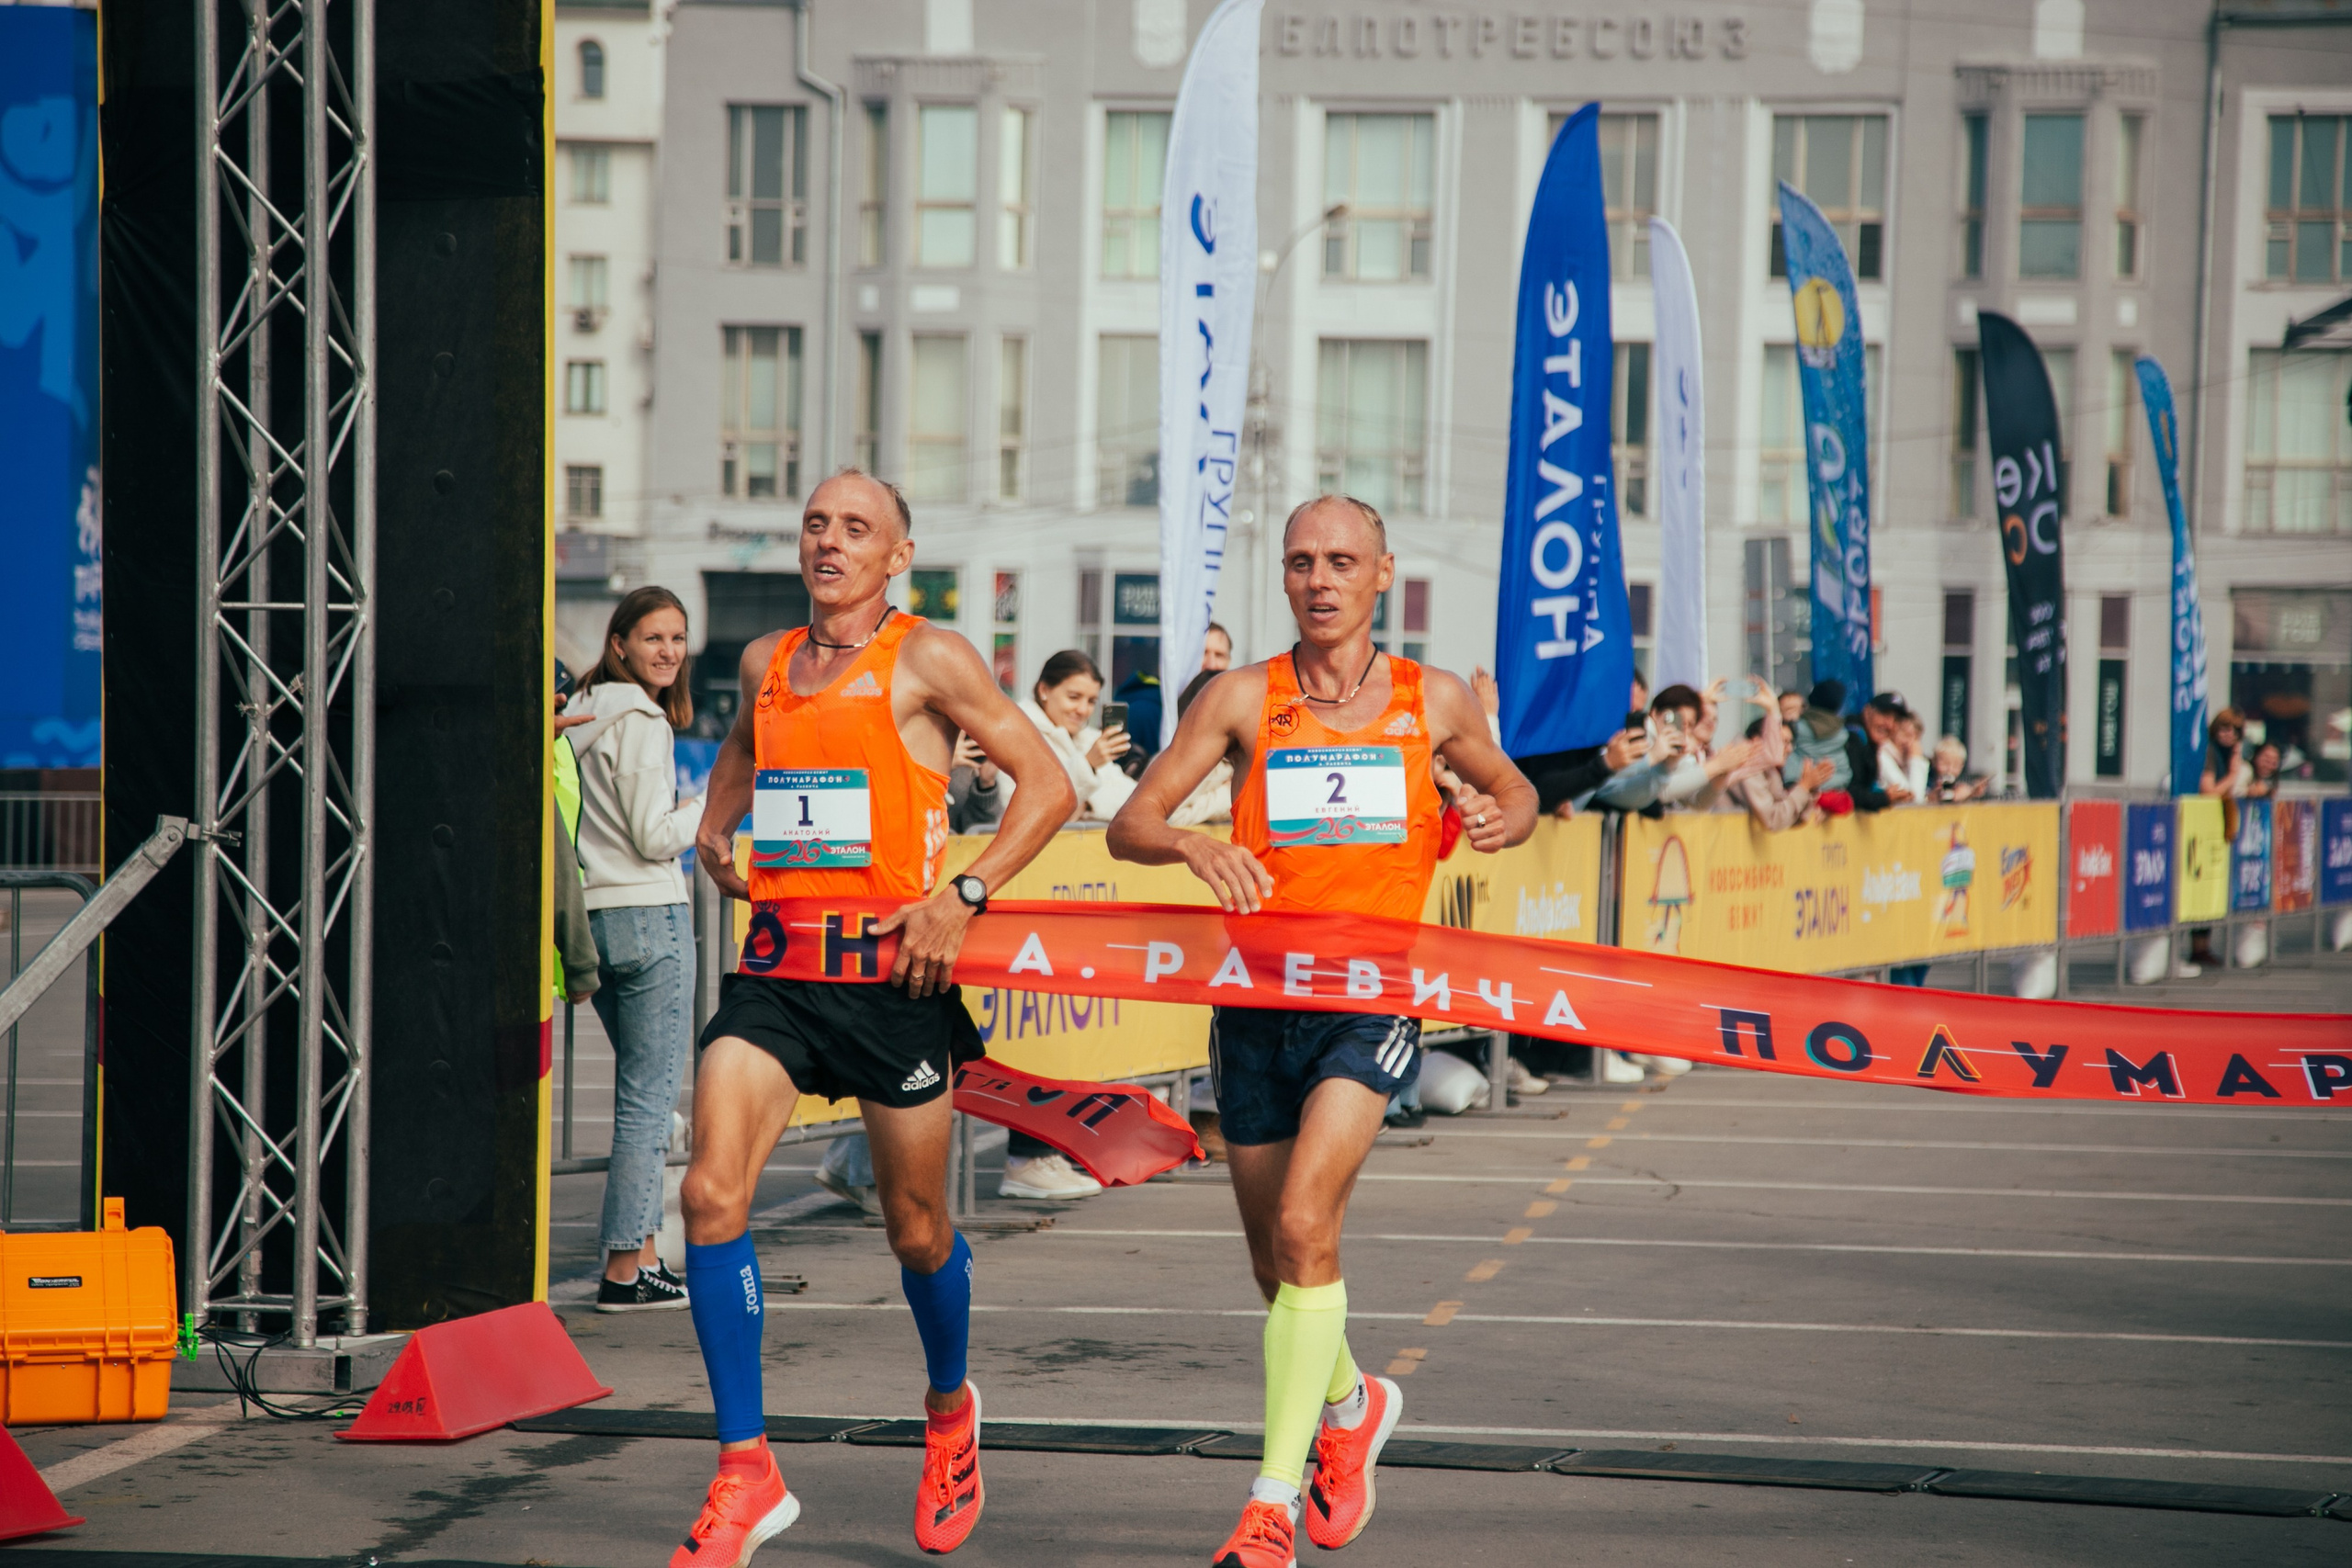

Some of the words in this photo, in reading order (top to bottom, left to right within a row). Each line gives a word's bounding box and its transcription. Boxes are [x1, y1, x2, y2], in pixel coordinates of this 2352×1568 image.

[1260, 9, 1748, 60] БЛПОТРЕБСОЮЗ
[1531, 279, 1583, 660] ЭТАЛОН
[1286, 753, 1376, 762] ПОЛУМАРАФОН
[1326, 772, 1347, 804] 2
[797, 795, 814, 827] 1
[1364, 823, 1402, 831] ЭТАЛОН
[830, 846, 866, 854] ЭТАЛОН
[1795, 885, 1850, 939] ЭТАЛОН
[1008, 931, 1096, 979] А.
[1144, 940, 1588, 1031] РАЕВИЧА
[1718, 1007, 2352, 1100] ПОЛУМАР
[901, 1072, 941, 1091] adidas
